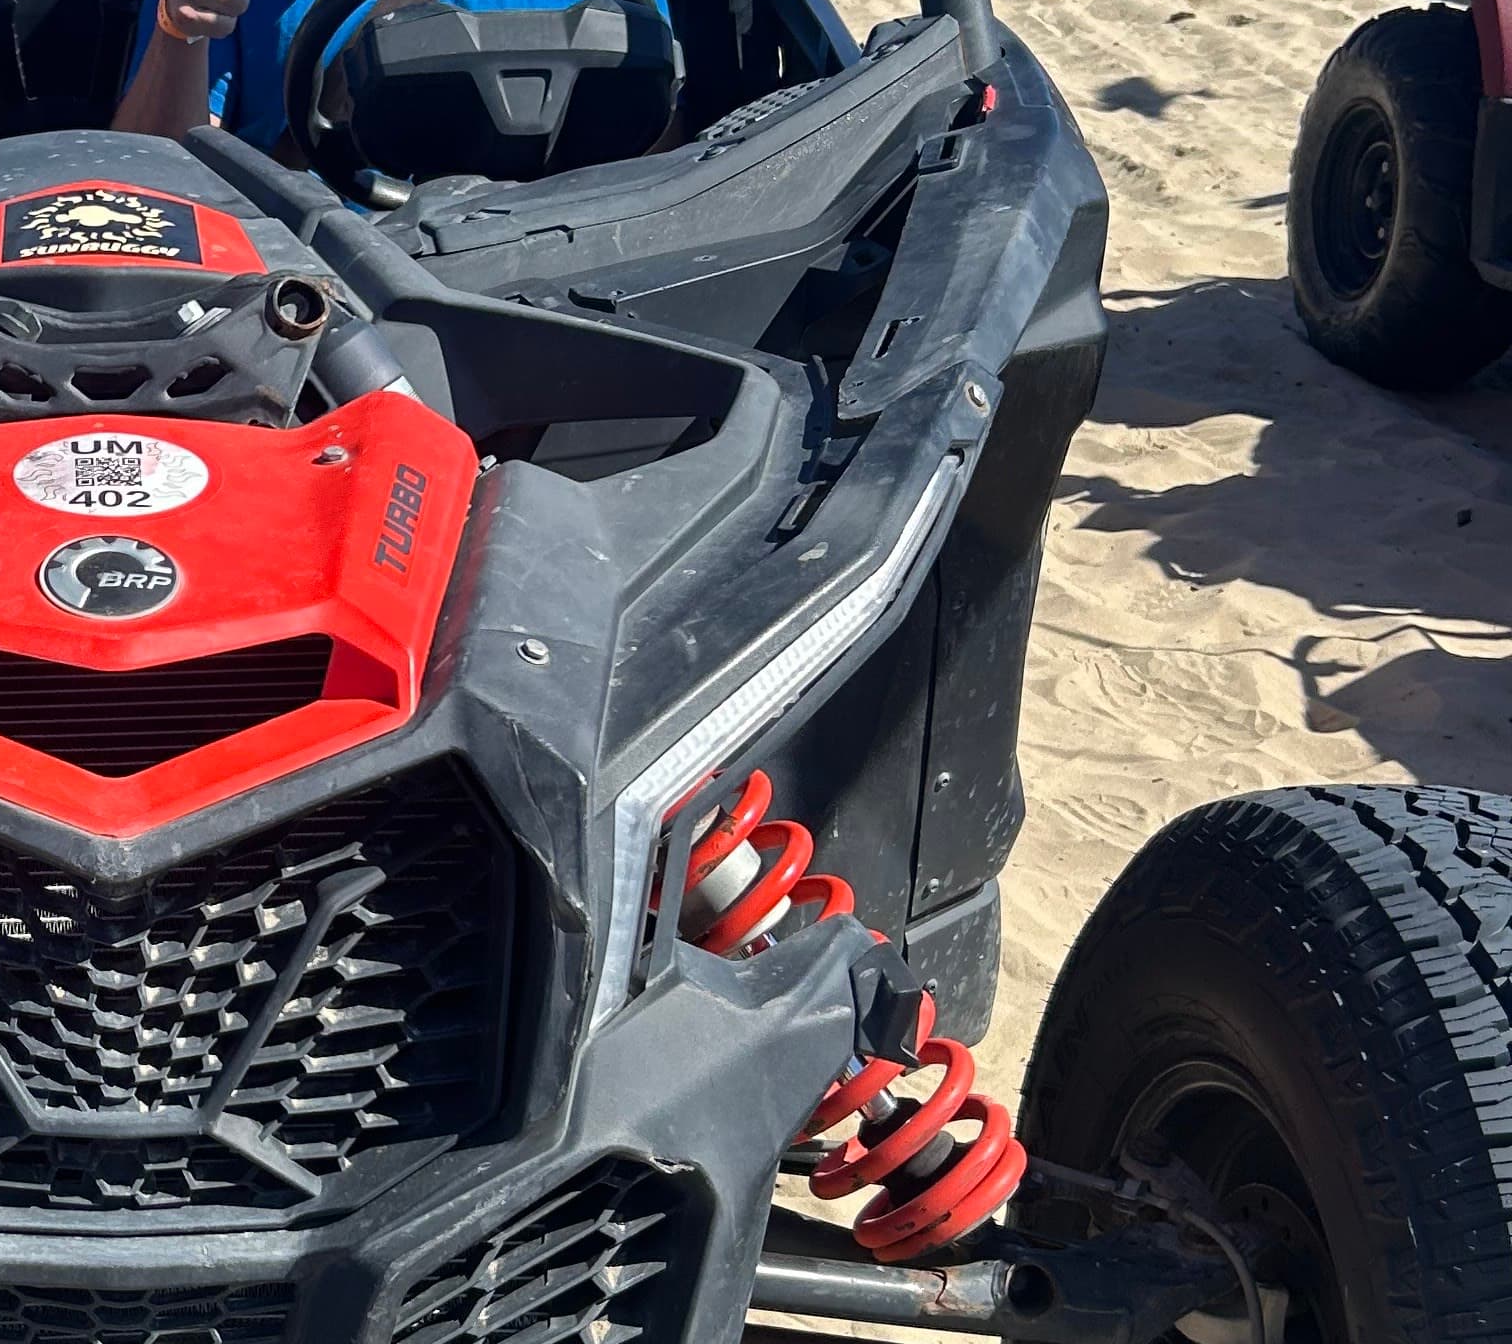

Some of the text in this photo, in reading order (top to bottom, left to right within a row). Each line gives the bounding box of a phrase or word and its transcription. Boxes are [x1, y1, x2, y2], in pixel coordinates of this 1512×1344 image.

[20, 242, 180, 258] SUNBUGGY
[71, 440, 143, 455] UM
[69, 490, 152, 508] 402
[375, 463, 427, 573] TURBO
[98, 571, 172, 590] BRP
